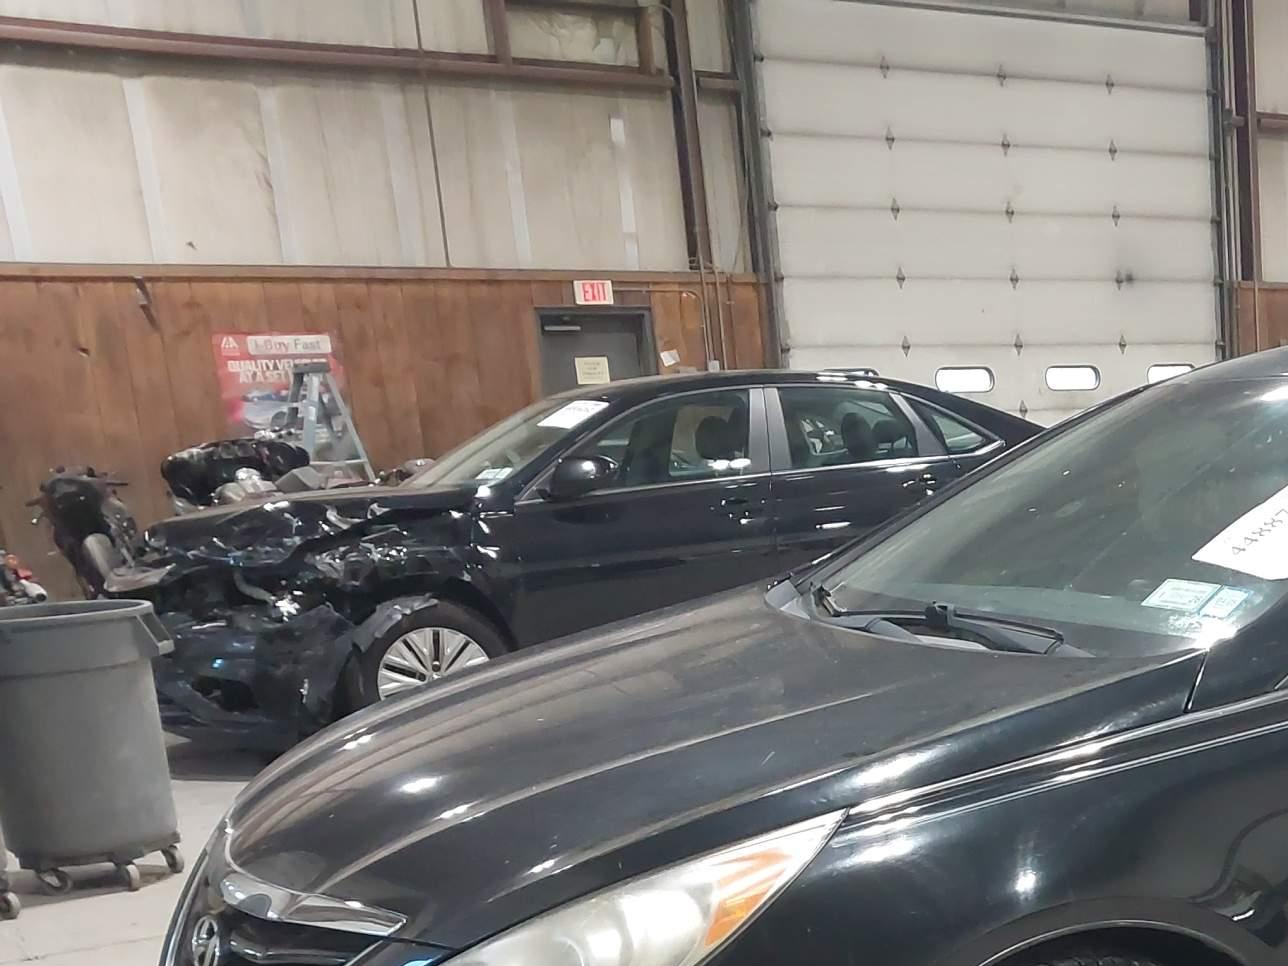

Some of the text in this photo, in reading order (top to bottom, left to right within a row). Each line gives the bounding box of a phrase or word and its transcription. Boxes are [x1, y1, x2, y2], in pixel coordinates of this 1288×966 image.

[581, 282, 607, 302] EXIT
[294, 338, 321, 351] Fast
[227, 359, 274, 372] QUALITY
